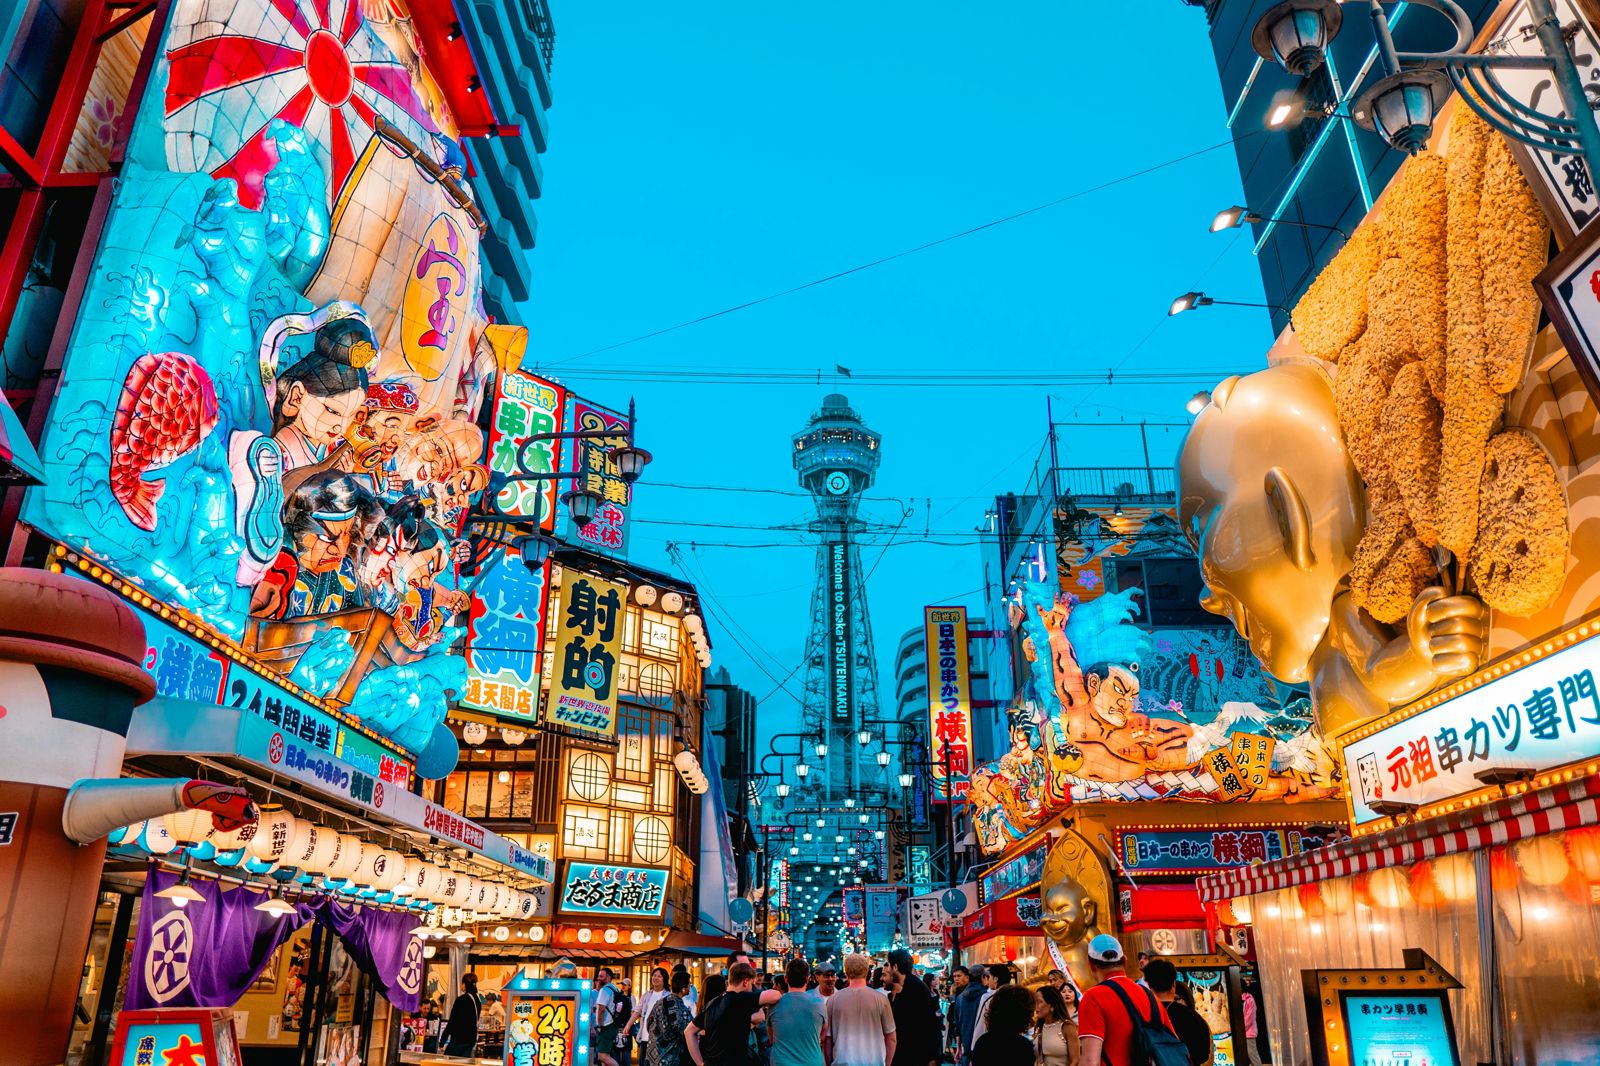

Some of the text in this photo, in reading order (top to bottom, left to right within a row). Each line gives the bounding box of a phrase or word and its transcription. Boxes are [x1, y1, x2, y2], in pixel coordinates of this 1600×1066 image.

[503, 374, 558, 412] 新世界
[582, 413, 627, 448] 24
[834, 545, 844, 589] Welcome
[834, 591, 844, 602] to
[468, 555, 543, 685] 横綱
[931, 611, 961, 624] 新世界
[561, 579, 621, 701] 射的
[938, 623, 960, 711] 日本一の串かつ
[230, 679, 332, 751] 24時間営業
[466, 679, 533, 715] 通天閣店
[556, 706, 610, 730] チャンピオン
[935, 711, 969, 778] 横綱
[1236, 737, 1251, 779] 串かつ
[1252, 740, 1268, 785] 日本一の
[285, 744, 350, 789] 日本一の串かつ
[424, 804, 464, 842] 24時間営業
[1138, 840, 1212, 860] 日本一の串かつ
[1211, 832, 1267, 864] 横綱
[566, 877, 662, 912] だるま商店
[1361, 1003, 1429, 1016] 串カツ早見表
